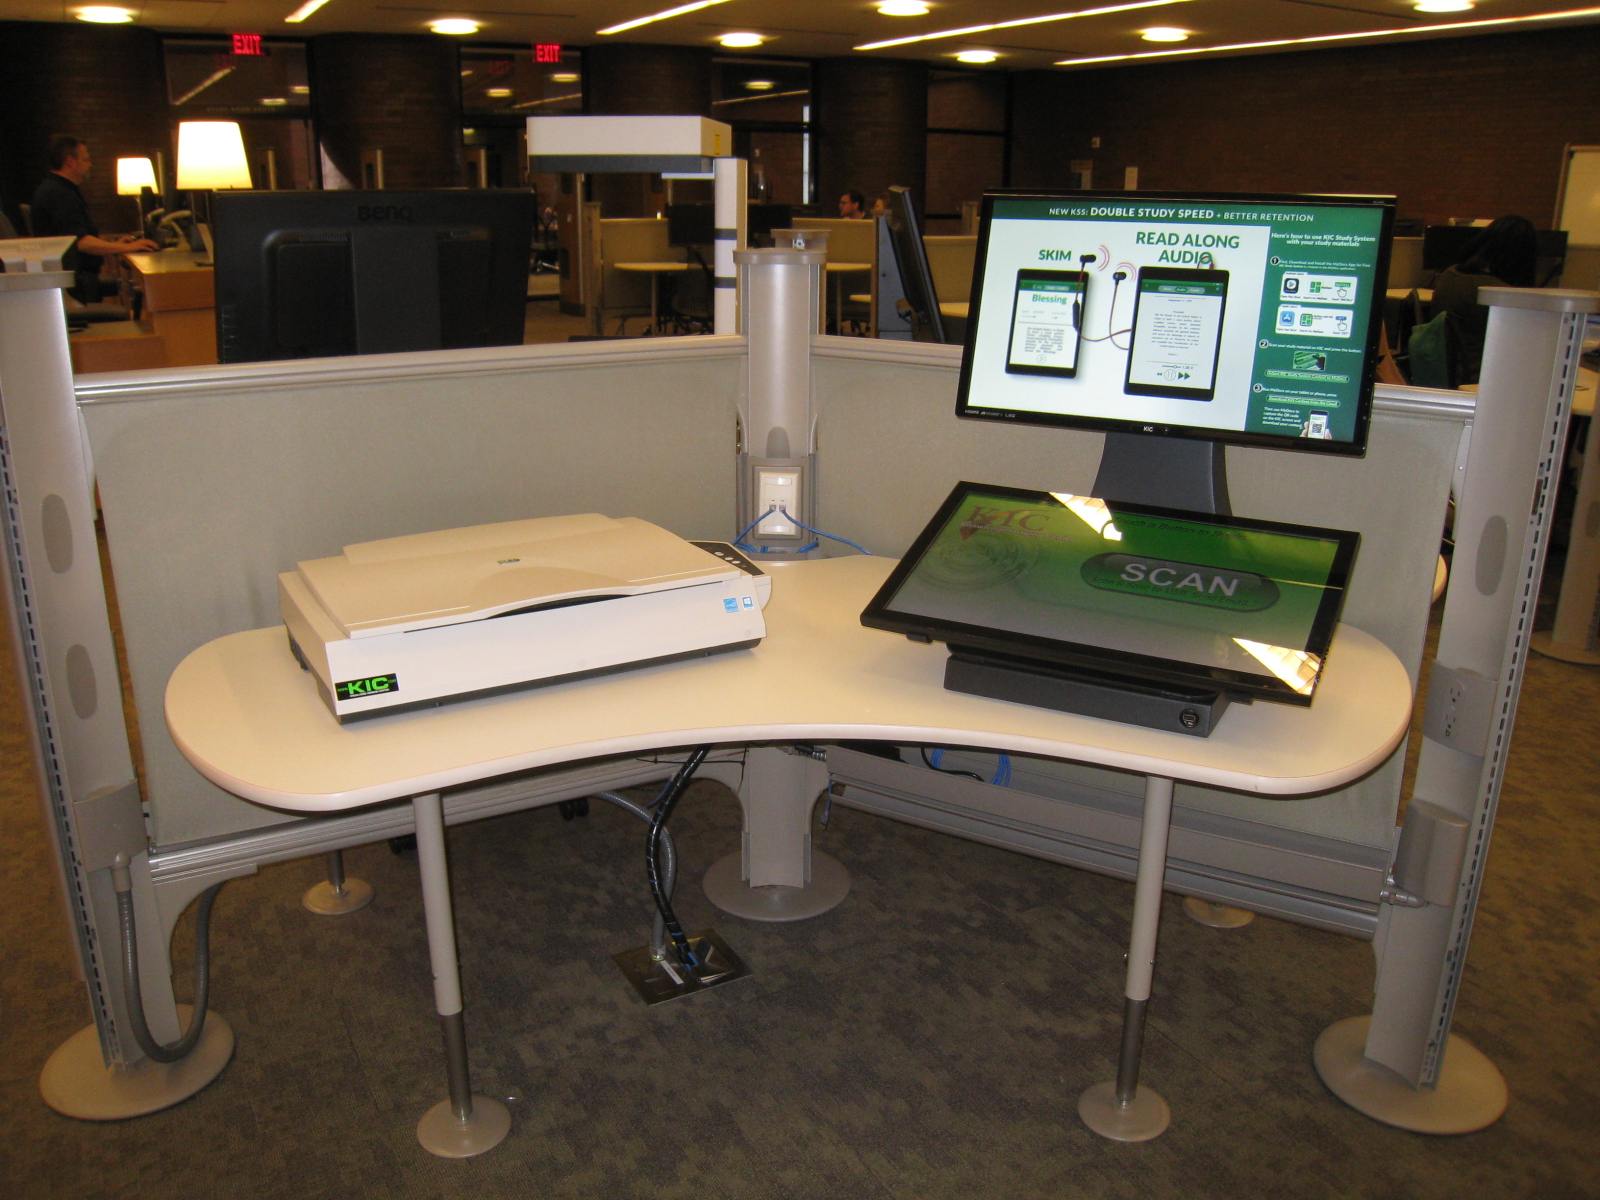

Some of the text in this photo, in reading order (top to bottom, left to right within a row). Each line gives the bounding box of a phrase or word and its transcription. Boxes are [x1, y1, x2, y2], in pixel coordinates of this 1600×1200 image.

[233, 34, 262, 55] EXIT
[536, 44, 560, 62] EXIT
[1049, 208, 1068, 216] NEW
[1070, 208, 1088, 216] KSS:
[1090, 207, 1135, 218] DOUBLE
[1137, 208, 1176, 218] STUDY
[1177, 209, 1214, 219] SPEED
[1224, 212, 1258, 220] BETTER
[1260, 213, 1314, 222] RETENTION
[1136, 231, 1240, 249] READ ALONG
[1038, 248, 1072, 262] SKIM
[1158, 250, 1213, 265] AUDIO
[1032, 294, 1067, 305] Blessing
[960, 522, 1006, 534] Knowledge
[1114, 517, 1146, 526] Touch
[1158, 523, 1194, 534] Button
[1120, 562, 1239, 597] SCAN
[1091, 576, 1114, 585] Scan
[1192, 592, 1218, 602] Send
[348, 676, 389, 695] KIC
